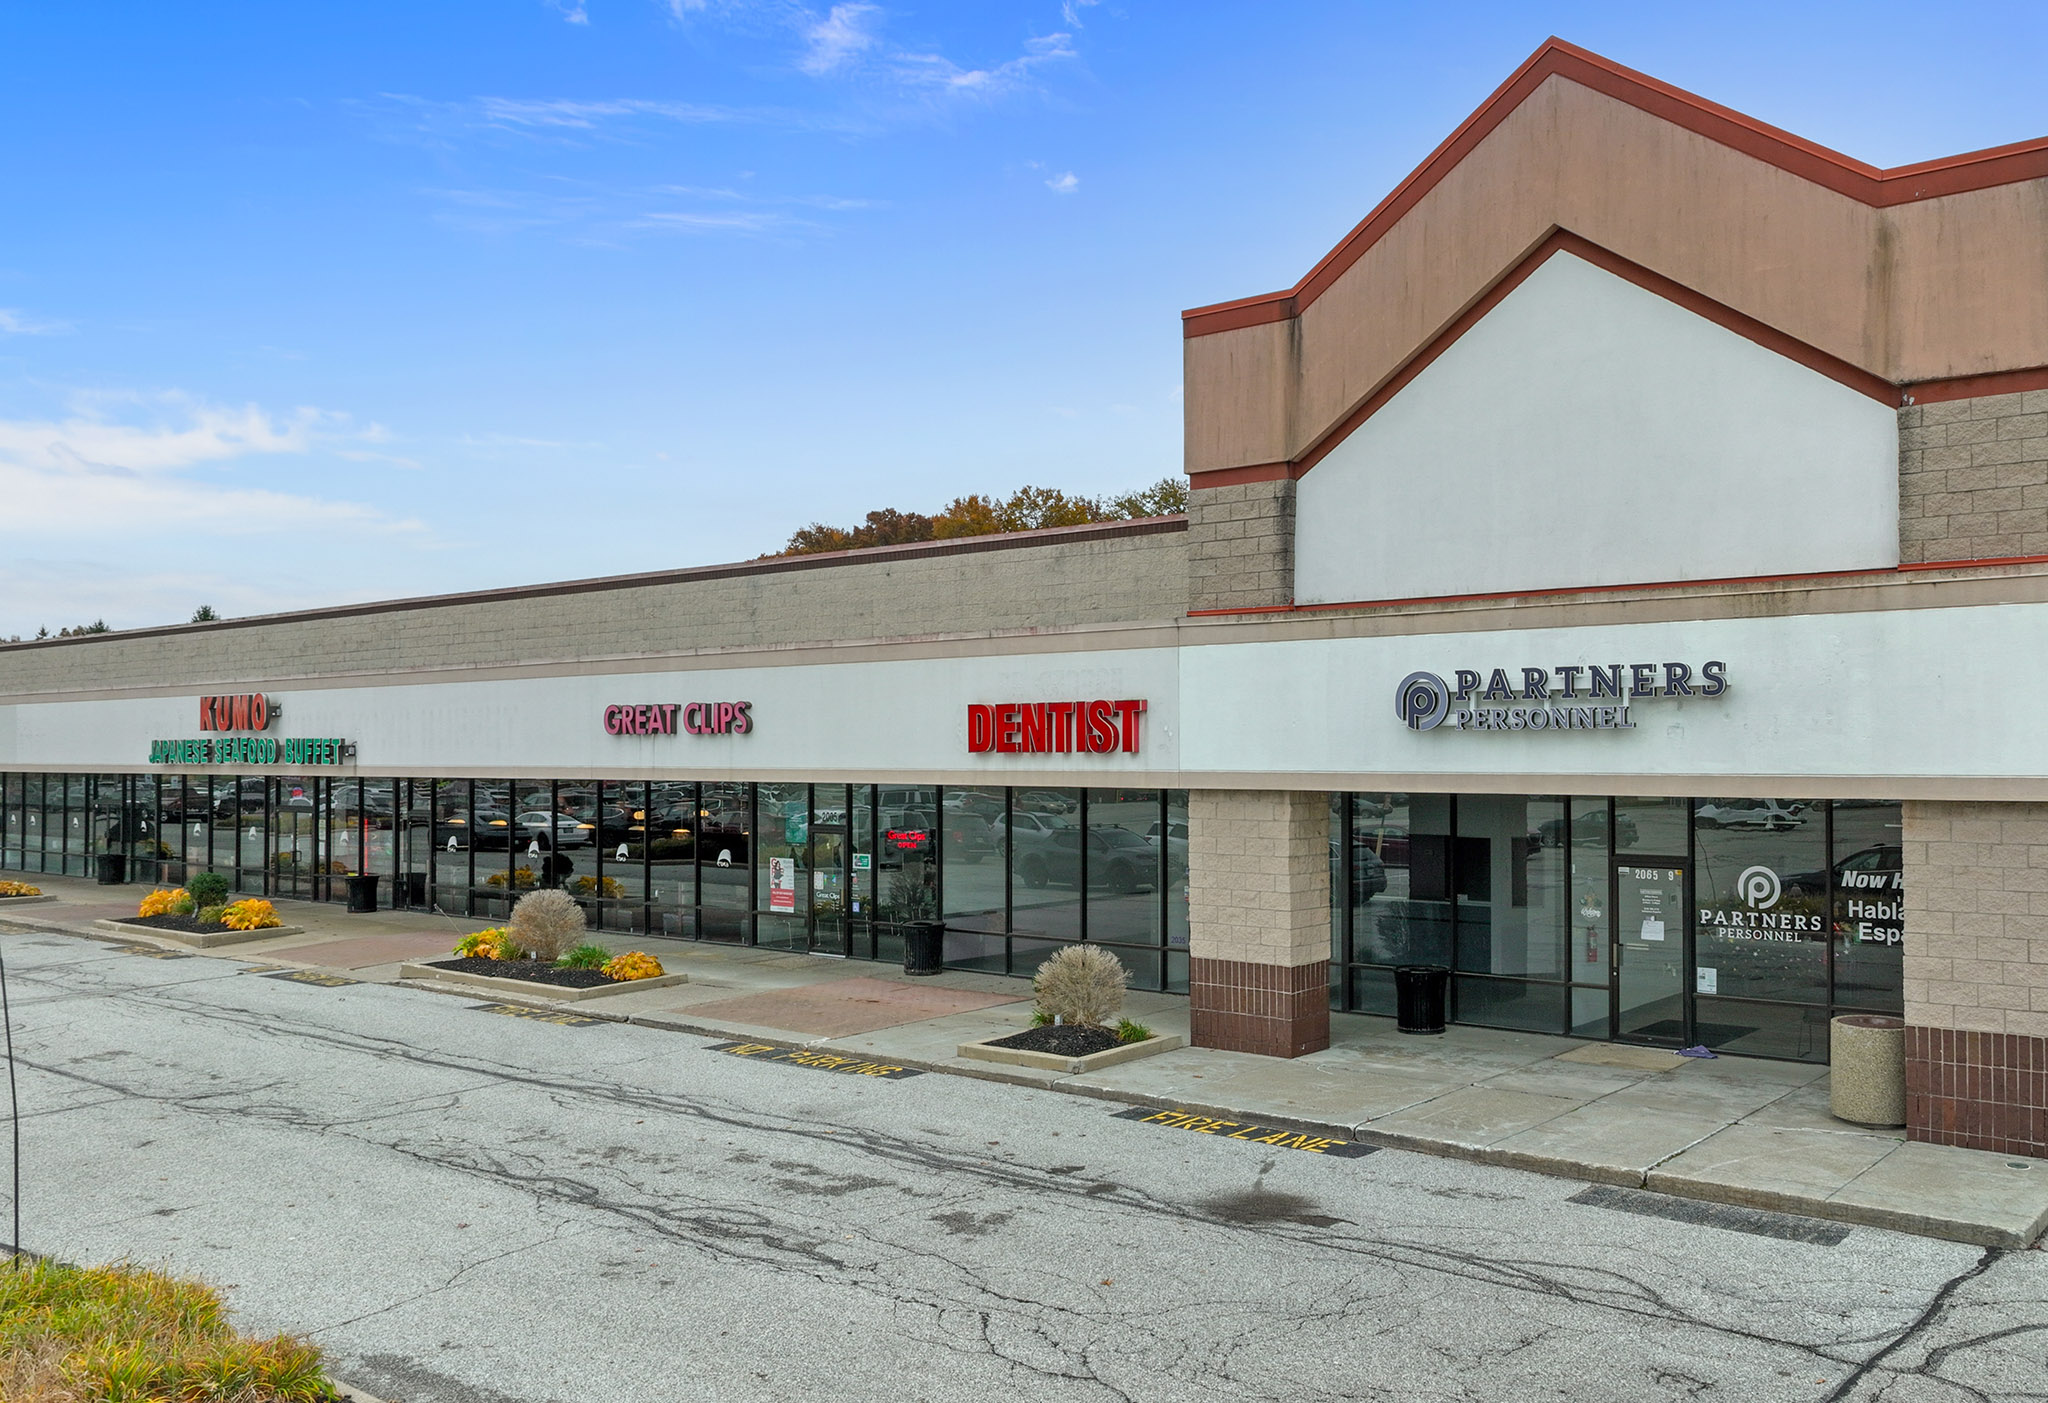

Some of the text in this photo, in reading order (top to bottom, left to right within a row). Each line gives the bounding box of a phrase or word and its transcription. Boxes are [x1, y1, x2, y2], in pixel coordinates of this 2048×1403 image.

[1454, 660, 1727, 702] PARTNERS
[200, 692, 270, 732] KUMO
[603, 700, 753, 736] GREAT CLIPS
[967, 699, 1148, 753] DENTIST
[1454, 704, 1637, 731] PERSONNEL
[149, 737, 345, 765] JAPANESE SEAFOOD BUFFET
[1634, 868, 1659, 881] 2065
[1841, 870, 1887, 889] Now
[1700, 909, 1822, 931] PARTNERS
[1719, 927, 1802, 943] PERSONNEL
[720, 1043, 904, 1077] NO PARKING
[1138, 1110, 1348, 1153] FIRE LANE
